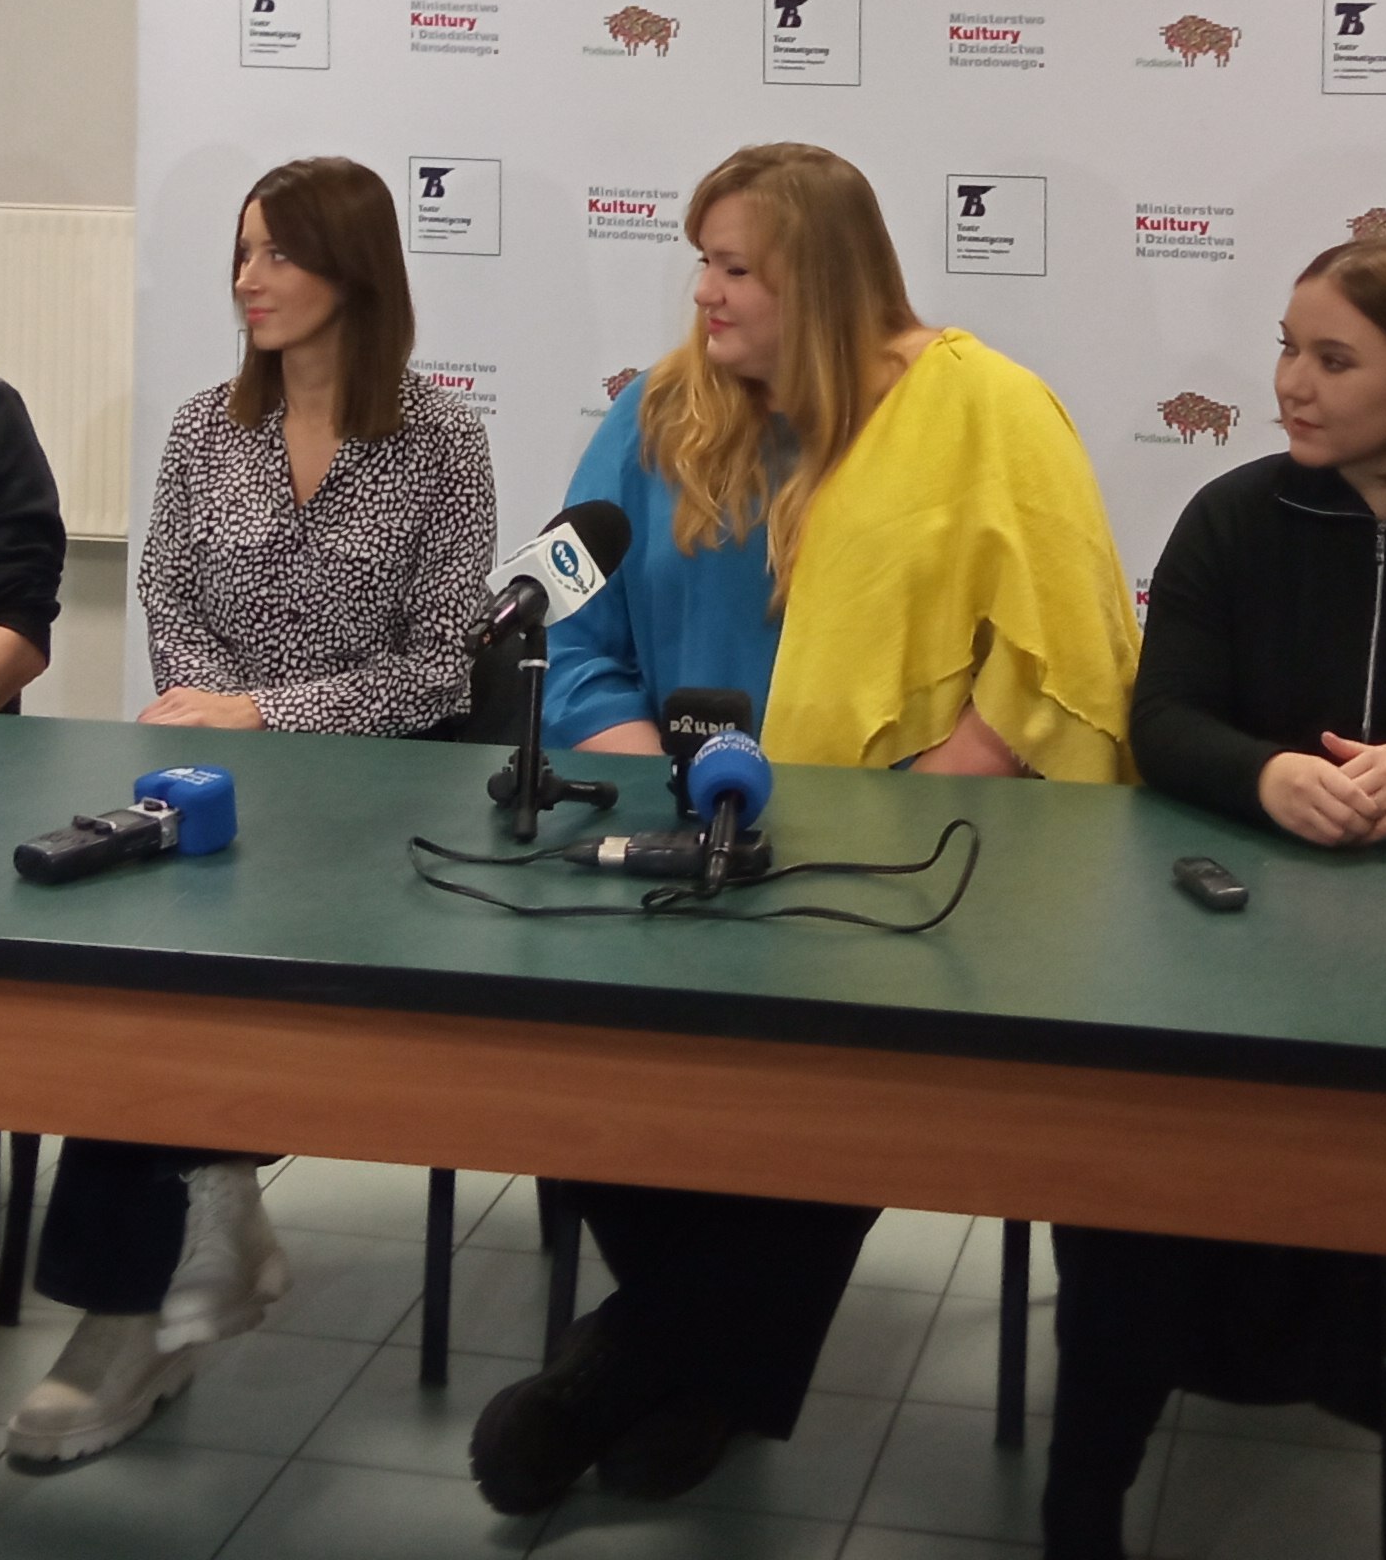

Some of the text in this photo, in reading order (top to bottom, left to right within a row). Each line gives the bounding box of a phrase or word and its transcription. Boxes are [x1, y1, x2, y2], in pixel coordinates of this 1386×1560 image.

[410, 12, 477, 31] Kultury
[949, 13, 1045, 24] Ministerstwo
[948, 26, 1021, 44] Kultury
[588, 187, 678, 200] Ministerstwo
[587, 199, 656, 218] Kultury
[1135, 203, 1235, 216] Ministerstwo
[1135, 216, 1210, 235] Kultury
[555, 543, 575, 573] tvn
